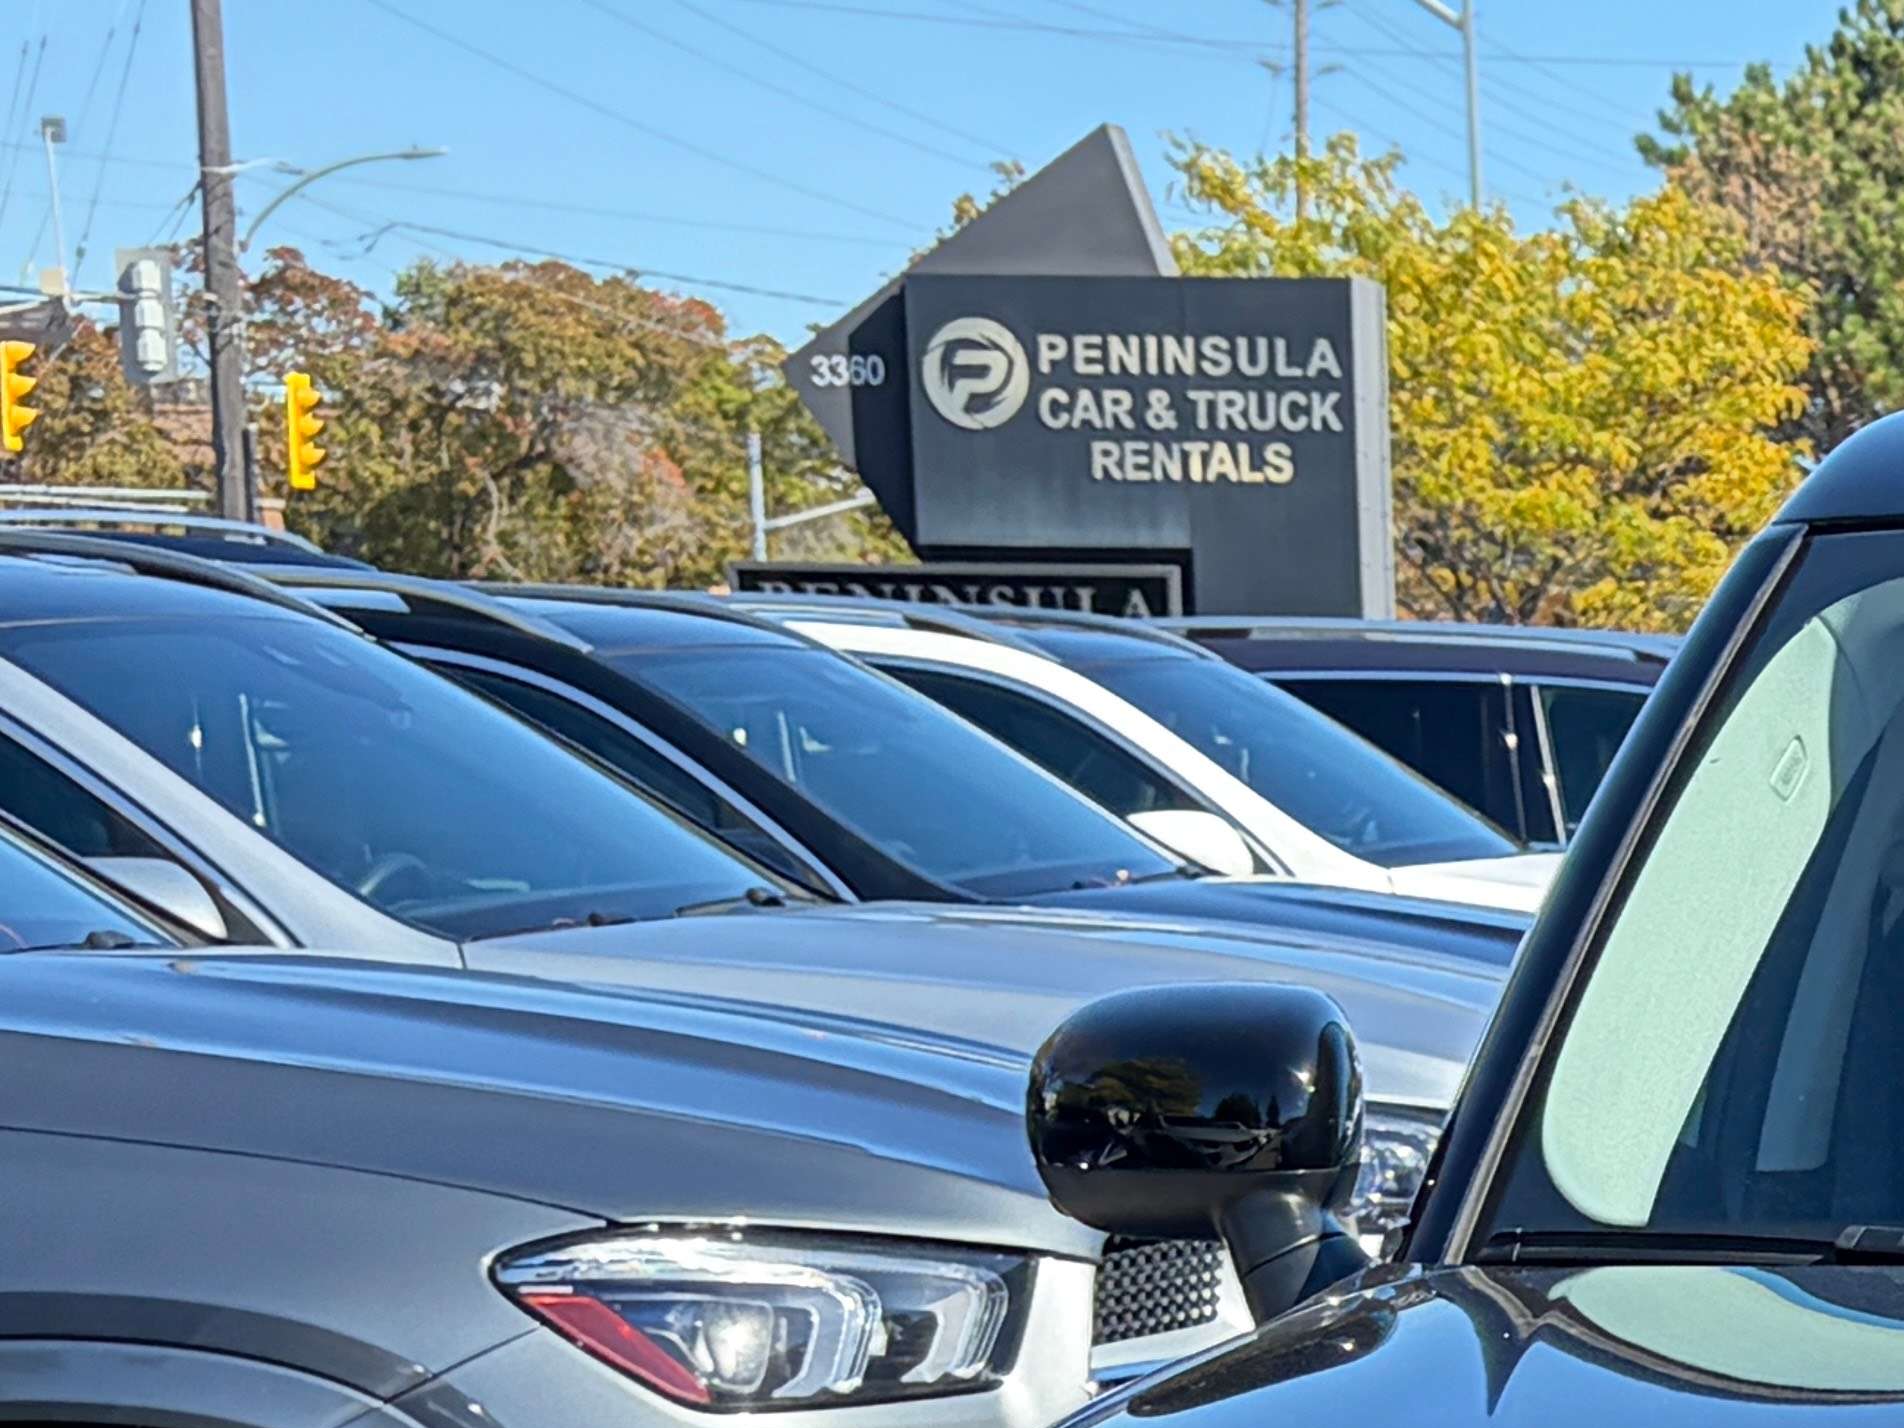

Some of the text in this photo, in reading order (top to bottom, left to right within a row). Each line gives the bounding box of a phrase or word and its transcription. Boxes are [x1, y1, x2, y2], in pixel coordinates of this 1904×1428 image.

[809, 353, 886, 388] 3360
[1037, 333, 1343, 379] PENINSULA
[1038, 389, 1344, 432] CAR & TRUCK
[1090, 440, 1294, 484] RENTALS
